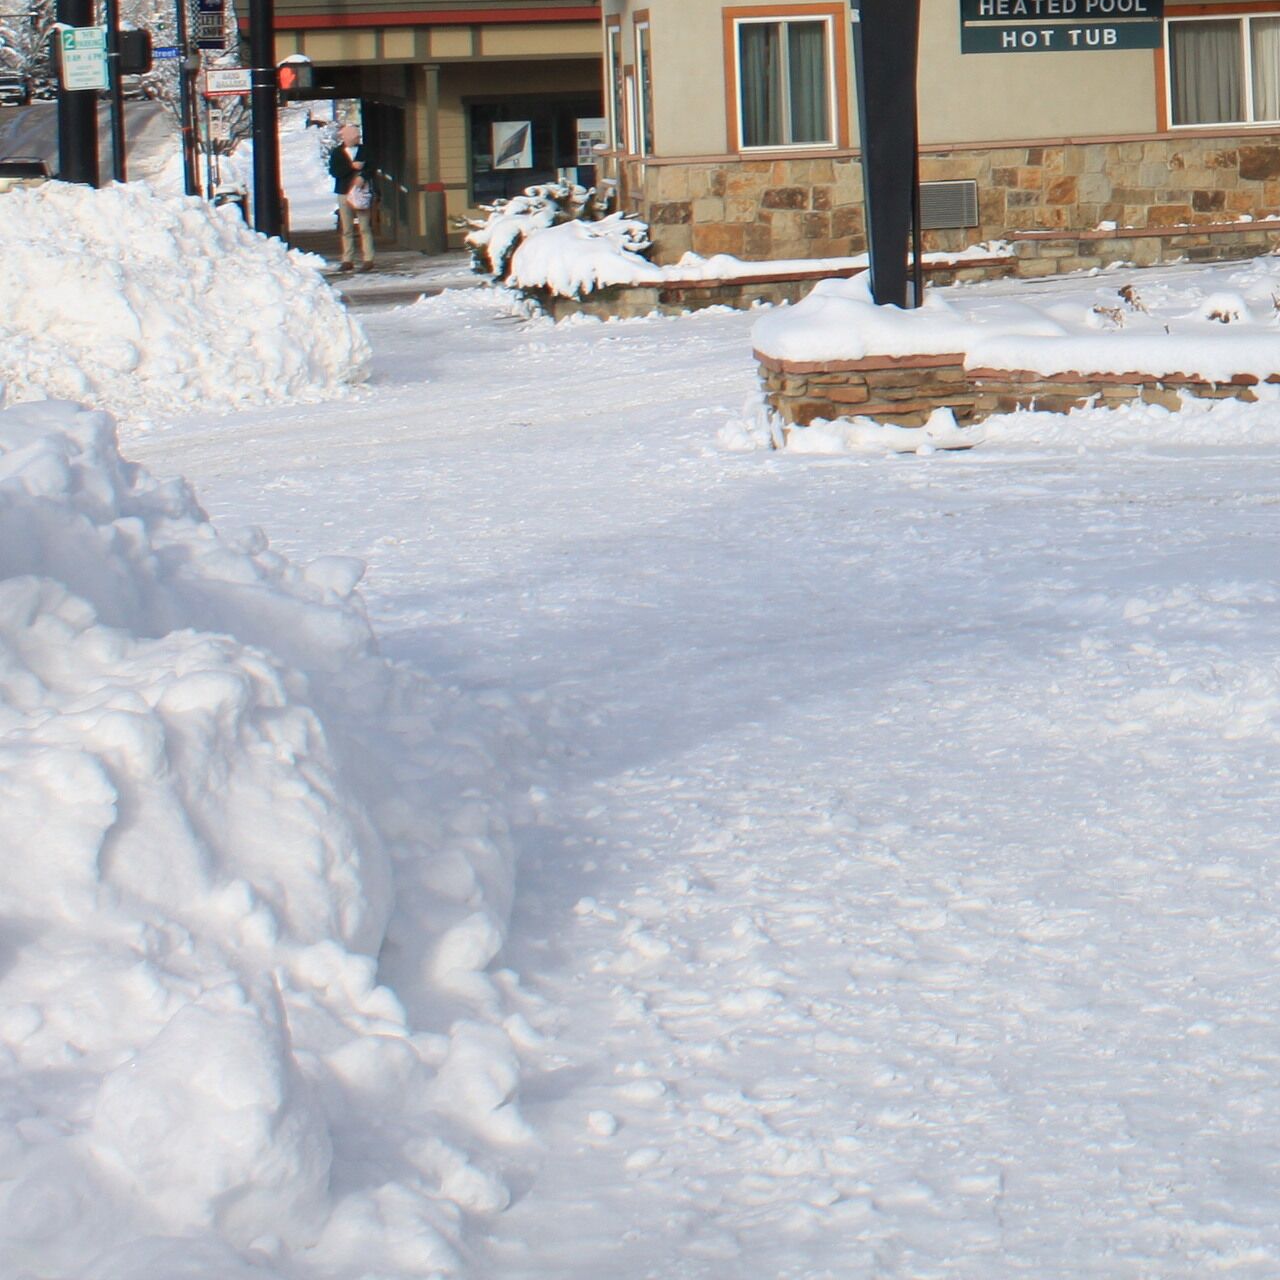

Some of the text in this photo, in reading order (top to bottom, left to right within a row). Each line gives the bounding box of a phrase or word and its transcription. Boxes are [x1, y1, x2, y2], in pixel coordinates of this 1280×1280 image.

[64, 32, 75, 49] 2
[1002, 28, 1118, 48] HOT TUB
